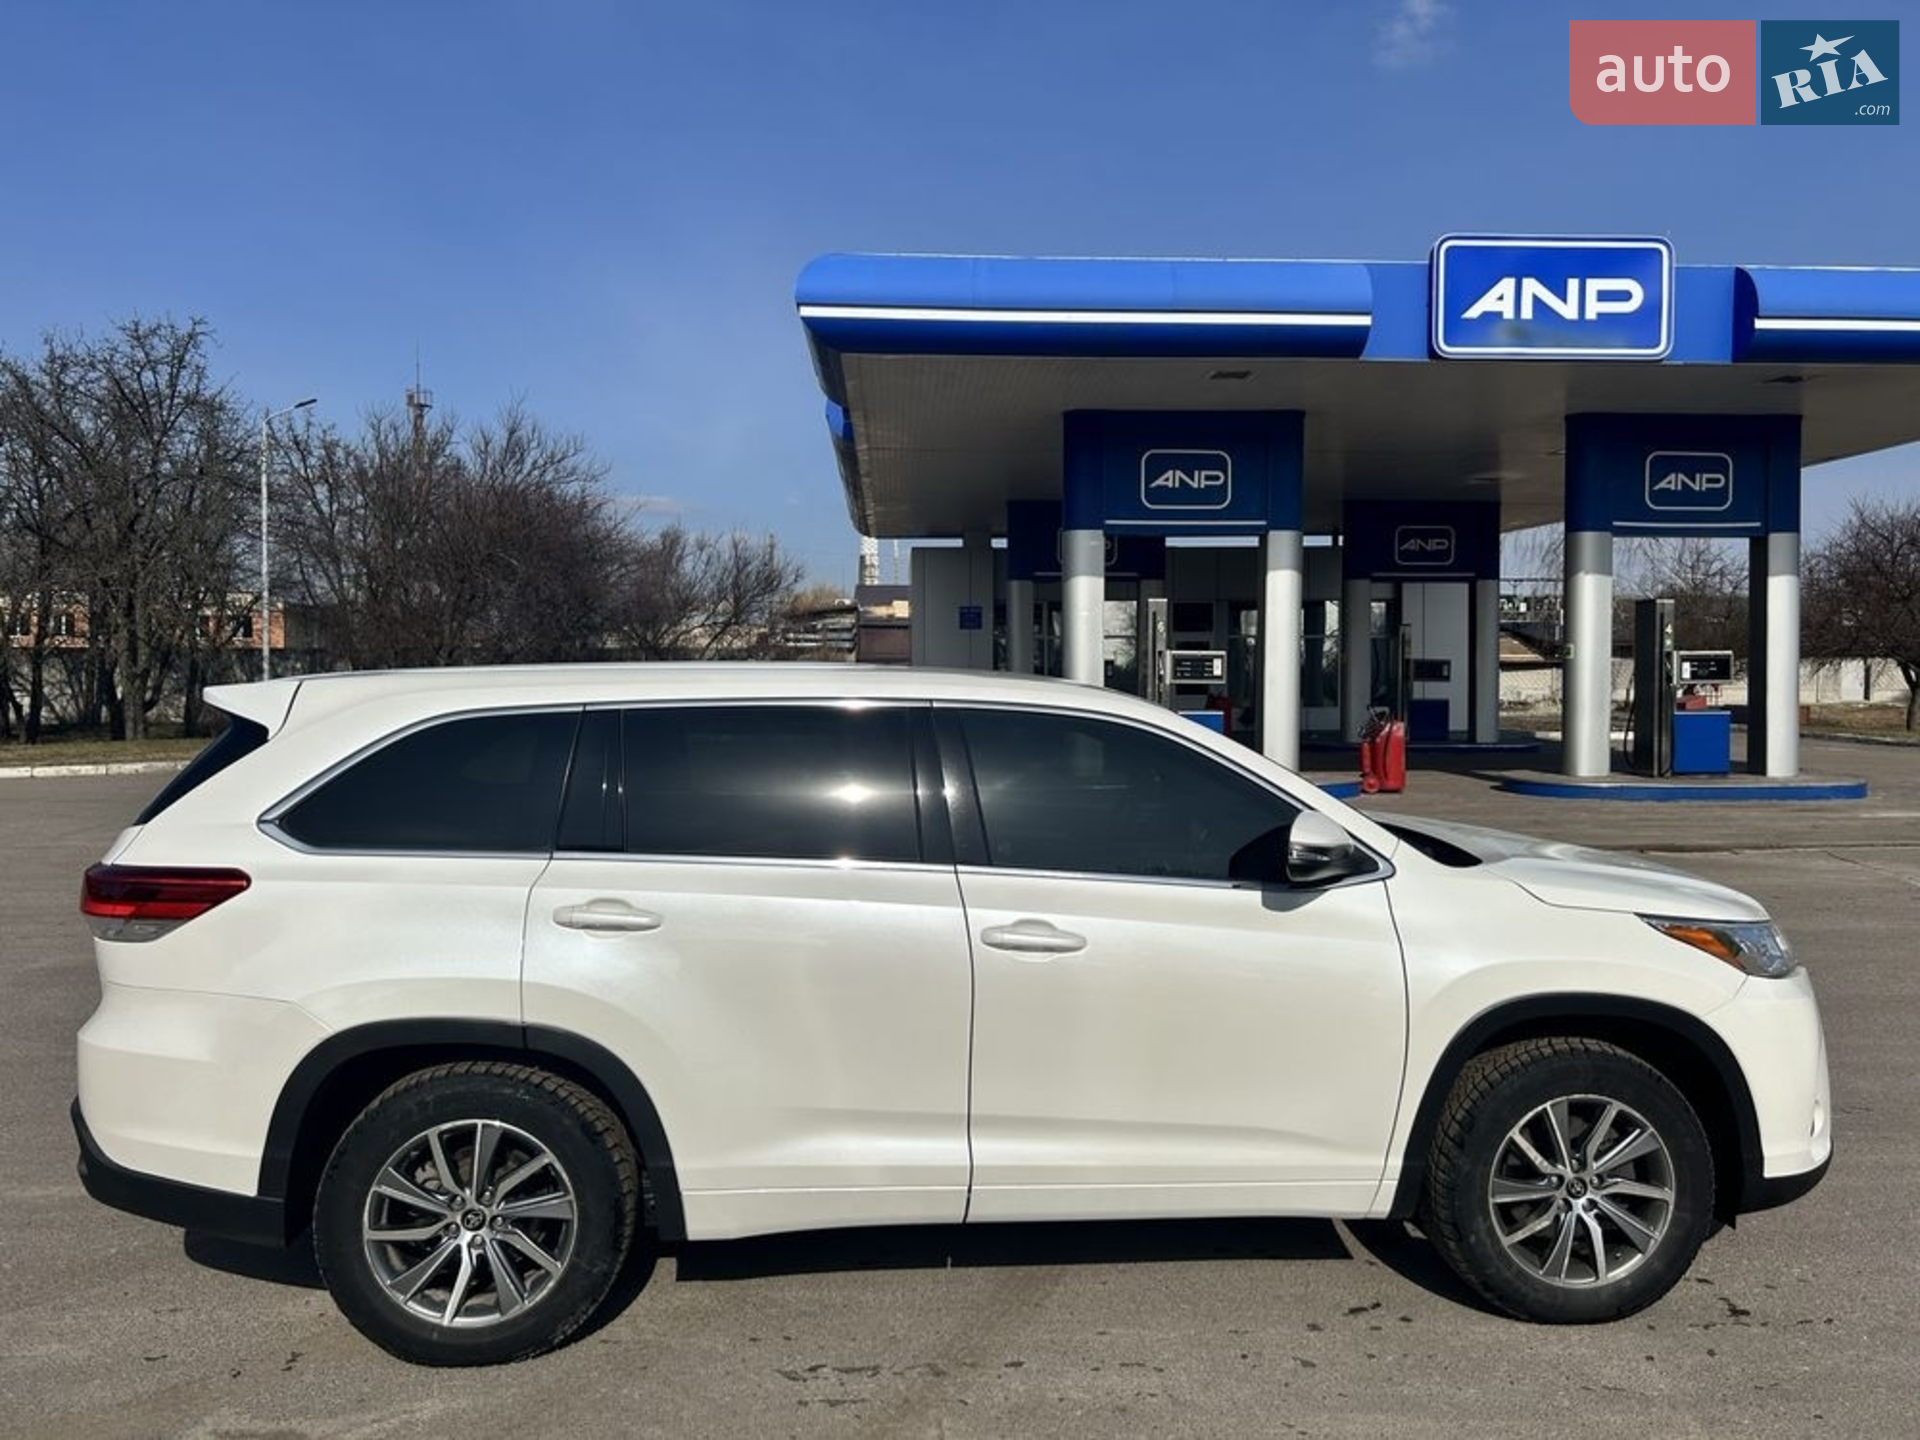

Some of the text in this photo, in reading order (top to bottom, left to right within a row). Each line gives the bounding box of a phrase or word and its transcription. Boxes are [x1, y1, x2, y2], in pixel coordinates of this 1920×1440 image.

[1461, 277, 1644, 320] ANP
[1150, 469, 1225, 488] ANP
[1653, 473, 1725, 491] ANP
[1400, 538, 1450, 551] ANP
